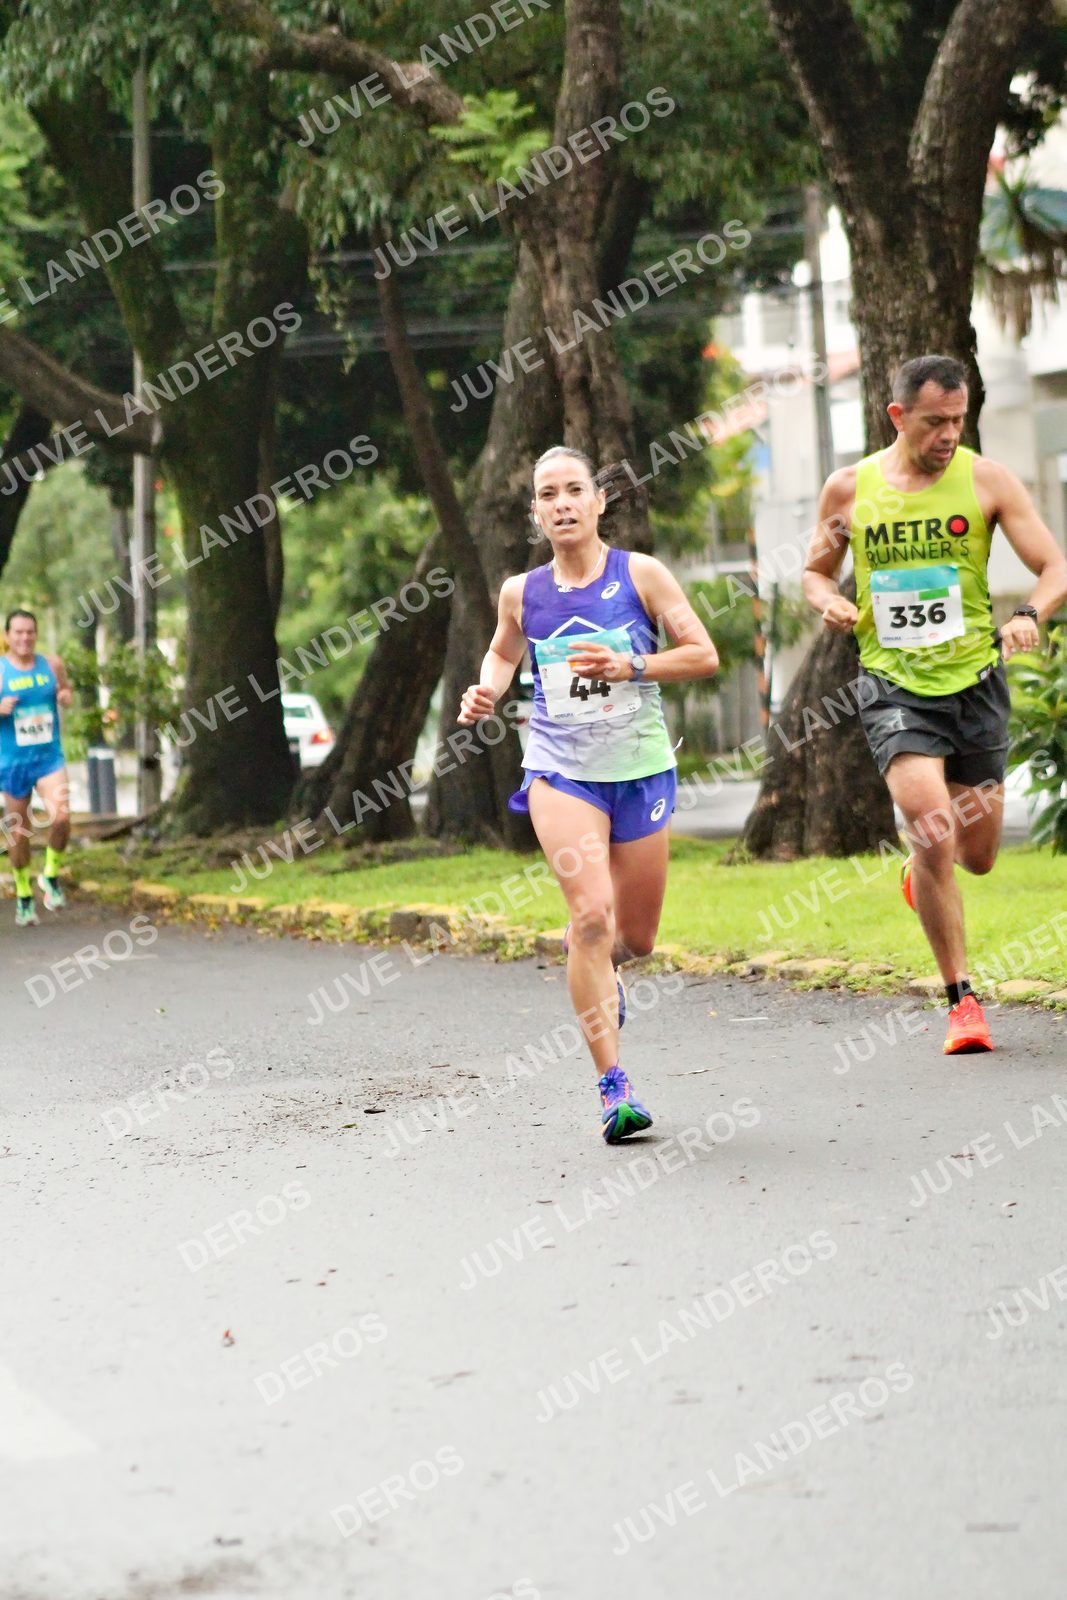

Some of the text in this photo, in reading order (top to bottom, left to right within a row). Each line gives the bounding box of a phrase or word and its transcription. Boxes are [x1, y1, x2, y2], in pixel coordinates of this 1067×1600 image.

[865, 514, 969, 549] METRO
[889, 602, 947, 629] 336
[570, 676, 611, 701] 44
